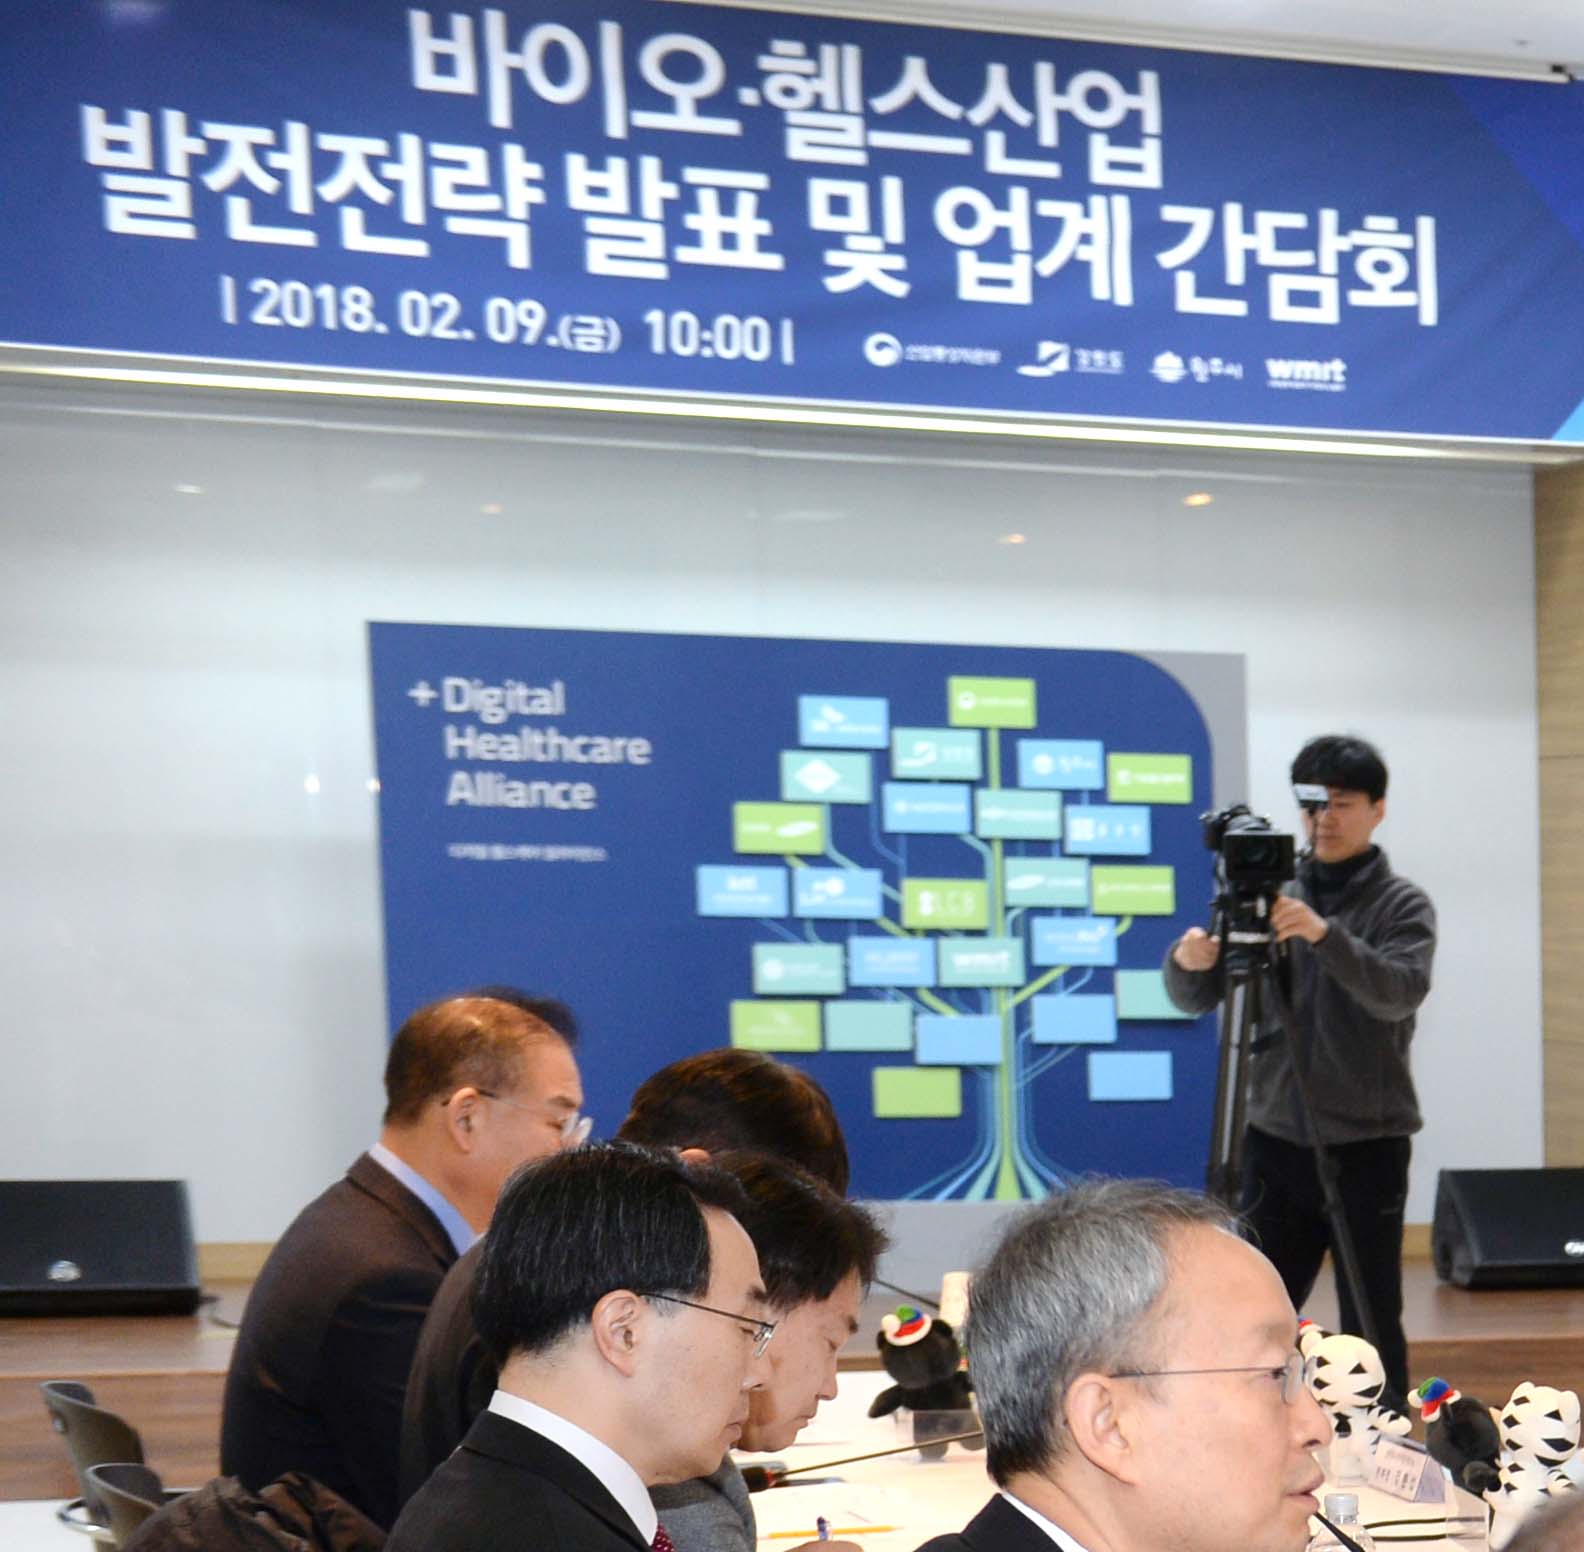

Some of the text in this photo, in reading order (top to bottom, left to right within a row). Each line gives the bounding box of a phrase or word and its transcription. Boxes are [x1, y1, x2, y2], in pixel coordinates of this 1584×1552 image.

[80, 104, 1438, 326] 발전전략 발표 및 업계 간담회
[250, 278, 388, 335] 2018.
[399, 290, 473, 343] 02.
[644, 309, 772, 364] 10:00
[442, 676, 565, 724] Digital
[443, 725, 652, 765] Healthcare
[446, 771, 597, 810] Alliance
